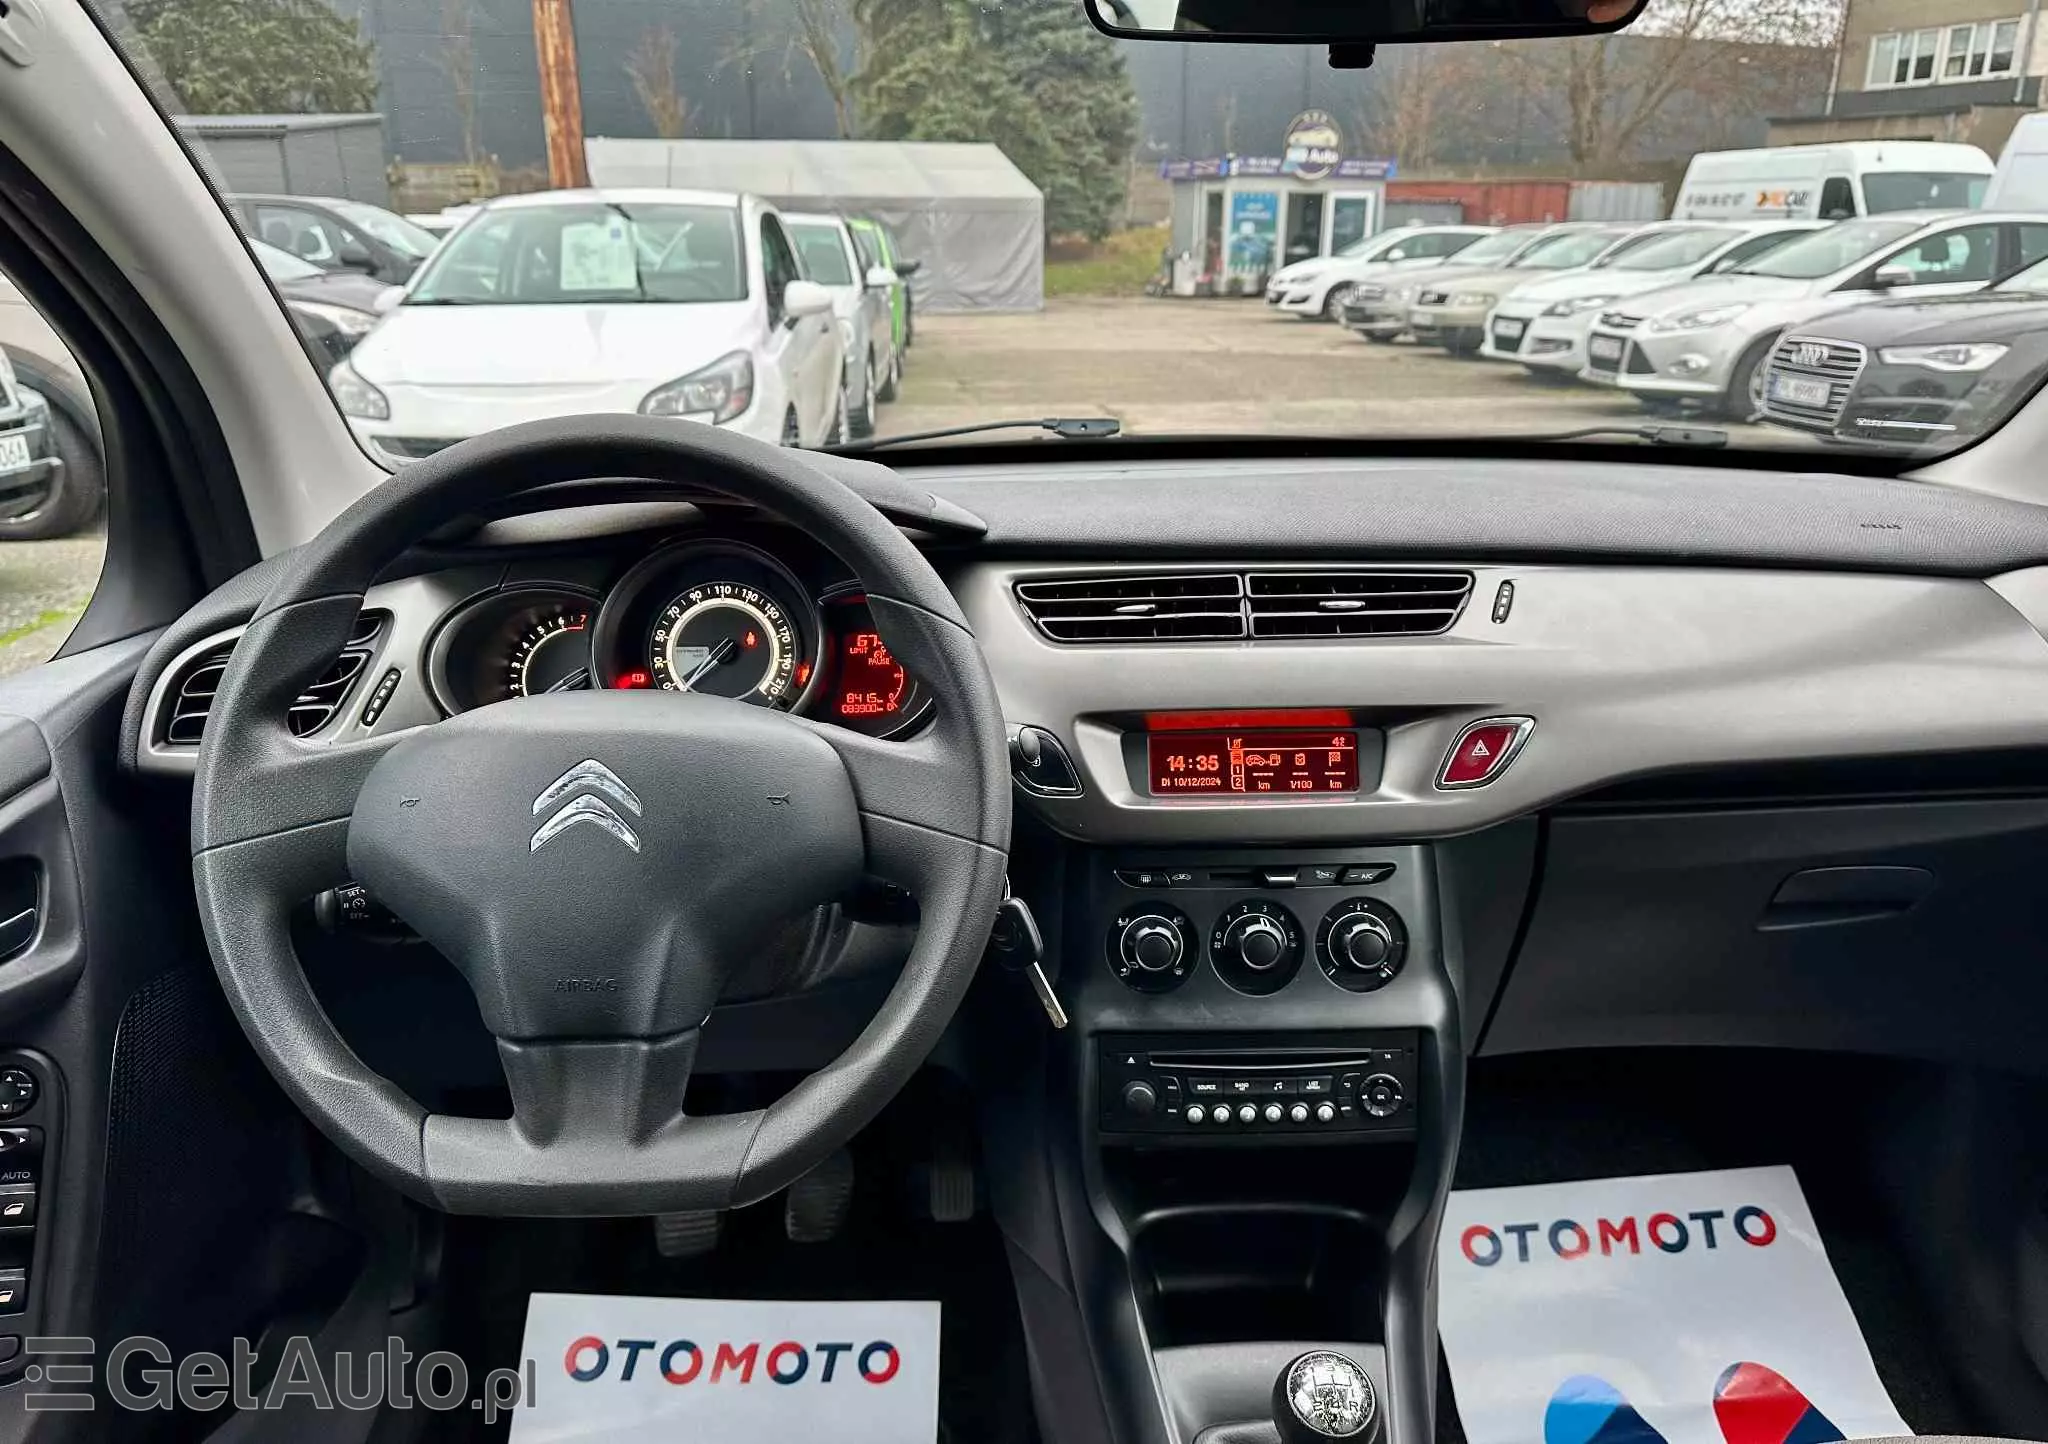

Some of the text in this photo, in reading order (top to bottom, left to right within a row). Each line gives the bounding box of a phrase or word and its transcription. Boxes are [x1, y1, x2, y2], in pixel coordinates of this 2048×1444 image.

[689, 590, 702, 601] 90
[713, 585, 732, 595] 110
[742, 588, 759, 602] 130
[667, 606, 680, 618] 70
[764, 602, 780, 619] 150
[558, 616, 565, 625] 6
[580, 614, 588, 623] 7
[536, 625, 545, 635] 5
[779, 626, 791, 643] 170
[654, 629, 666, 643] 50
[522, 641, 530, 649] 4
[511, 661, 521, 669] 3
[653, 656, 664, 669] 30
[781, 653, 792, 670] 190
[868, 657, 890, 665] PAUSE
[769, 677, 785, 695] 210
[1166, 754, 1220, 771] 14:35
[1174, 776, 1222, 787] 10/12/2024
[1257, 780, 1271, 790] km
[1329, 779, 1342, 789] km
[1215, 931, 1222, 939] 0
[553, 978, 619, 993] AIRBAG
[1, 1171, 31, 1180] AUTO
[1461, 1205, 1776, 1267] OTOMOTO
[565, 1335, 900, 1385] OTOMOTO
